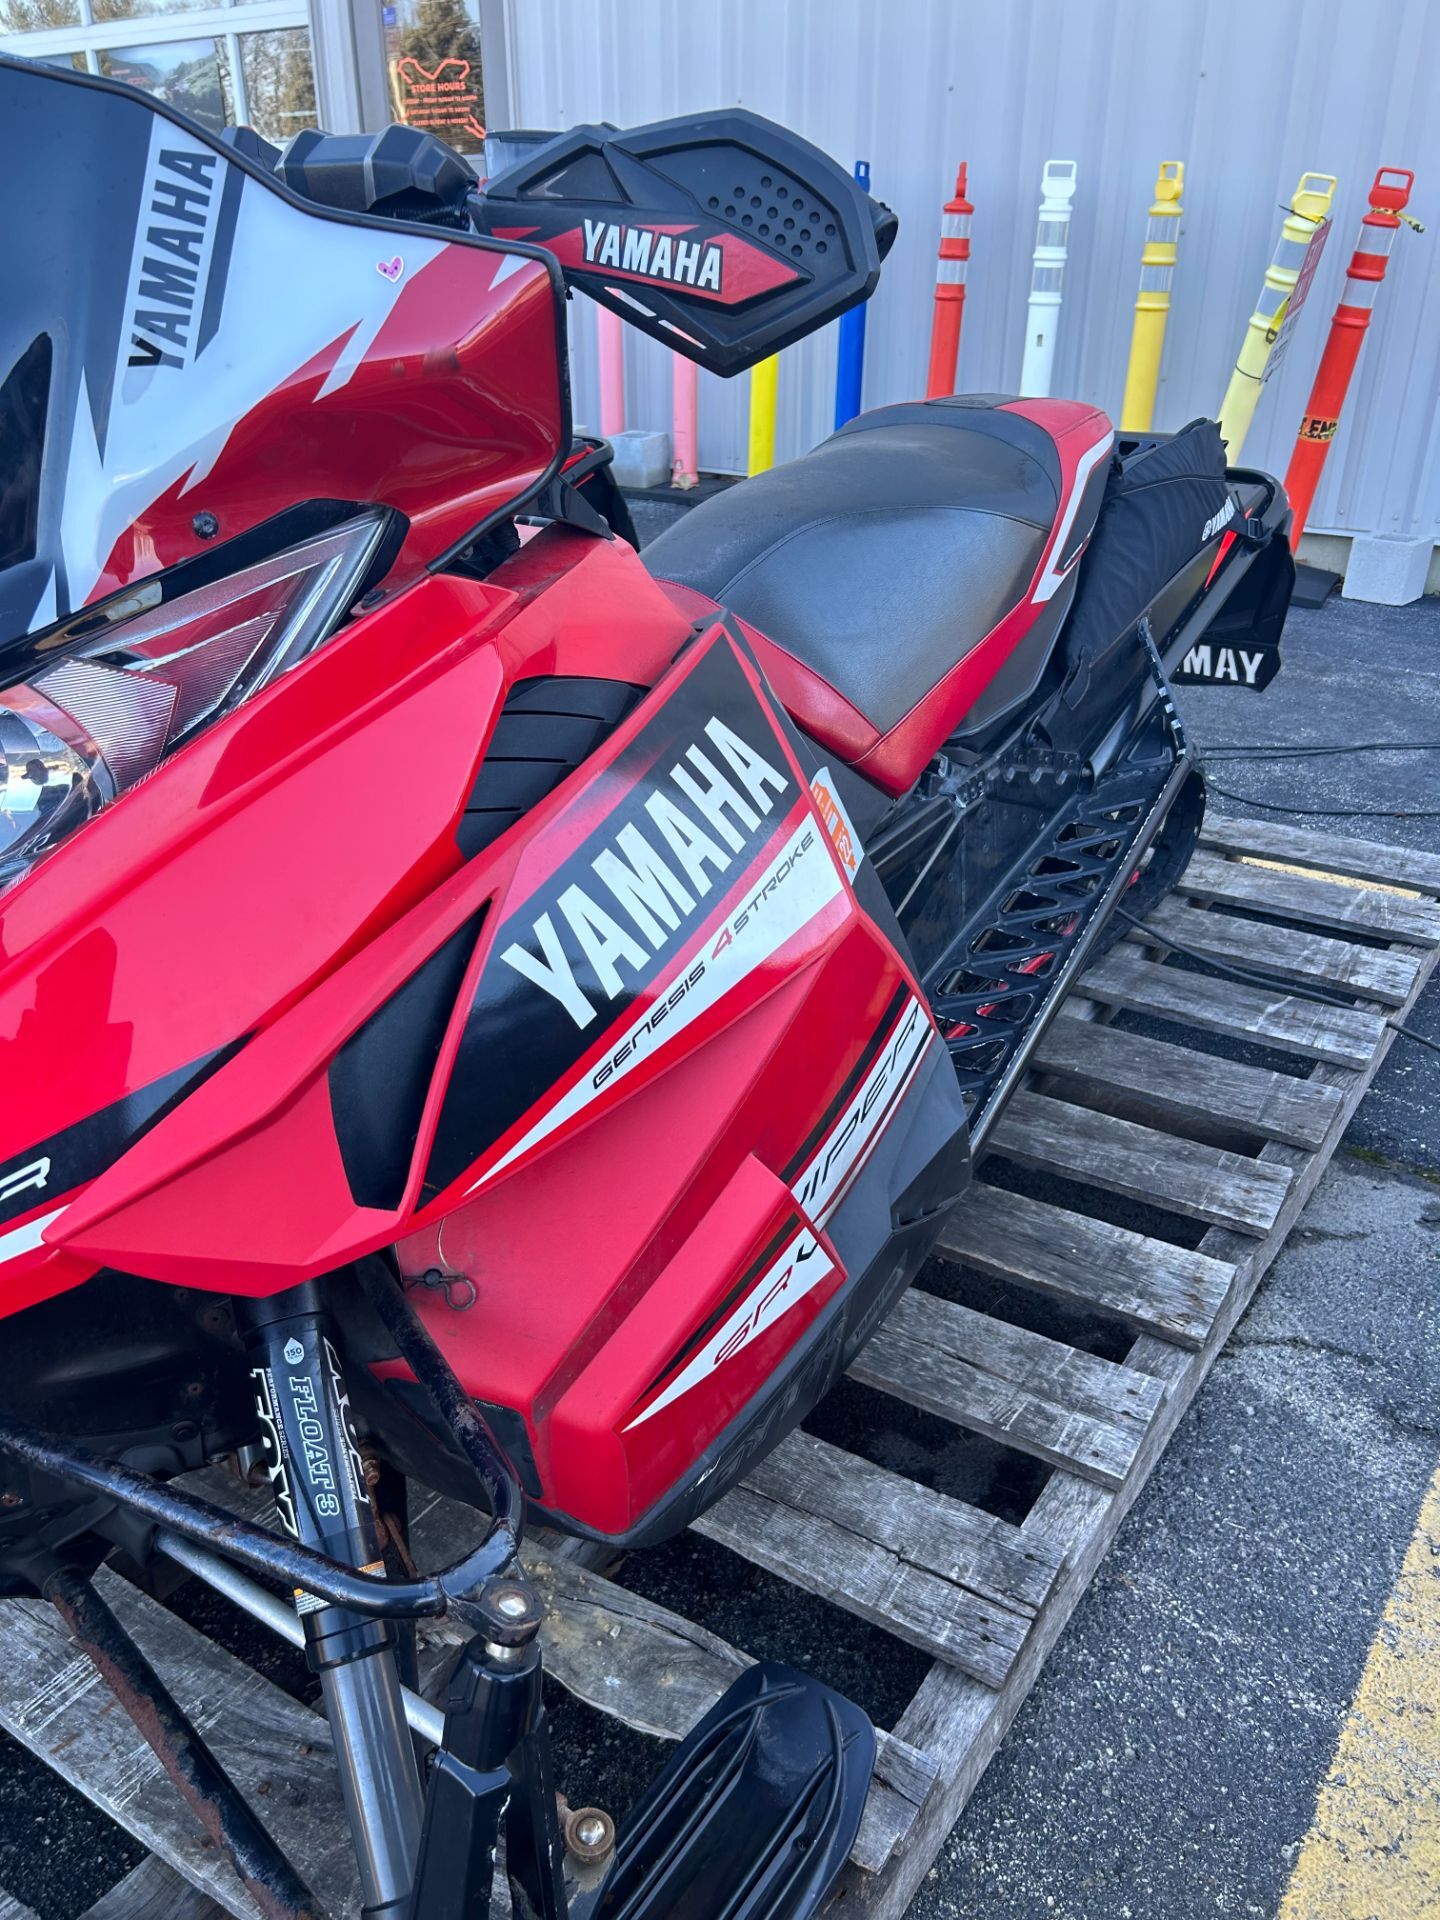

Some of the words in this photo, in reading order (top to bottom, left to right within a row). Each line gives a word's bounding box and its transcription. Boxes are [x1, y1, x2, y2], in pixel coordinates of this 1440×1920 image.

[411, 84, 436, 93] STORE
[437, 82, 466, 92] HOURS
[128, 149, 217, 370] YAMAHA
[584, 218, 721, 291] YAMAHA
[1177, 645, 1264, 684] MAY
[500, 716, 789, 1030] YAMAHA
[592, 960, 706, 1090] GENESIS
[711, 927, 733, 961] 4
[733, 831, 815, 936] STROKE
[286, 1347, 302, 1357] 150
[714, 1264, 794, 1366] SR
[265, 1367, 284, 1430] PERFORMANCE
[277, 1430, 290, 1460] SERIES
[288, 1376, 335, 1490] FLOAT
[315, 1493, 340, 1517] 3
